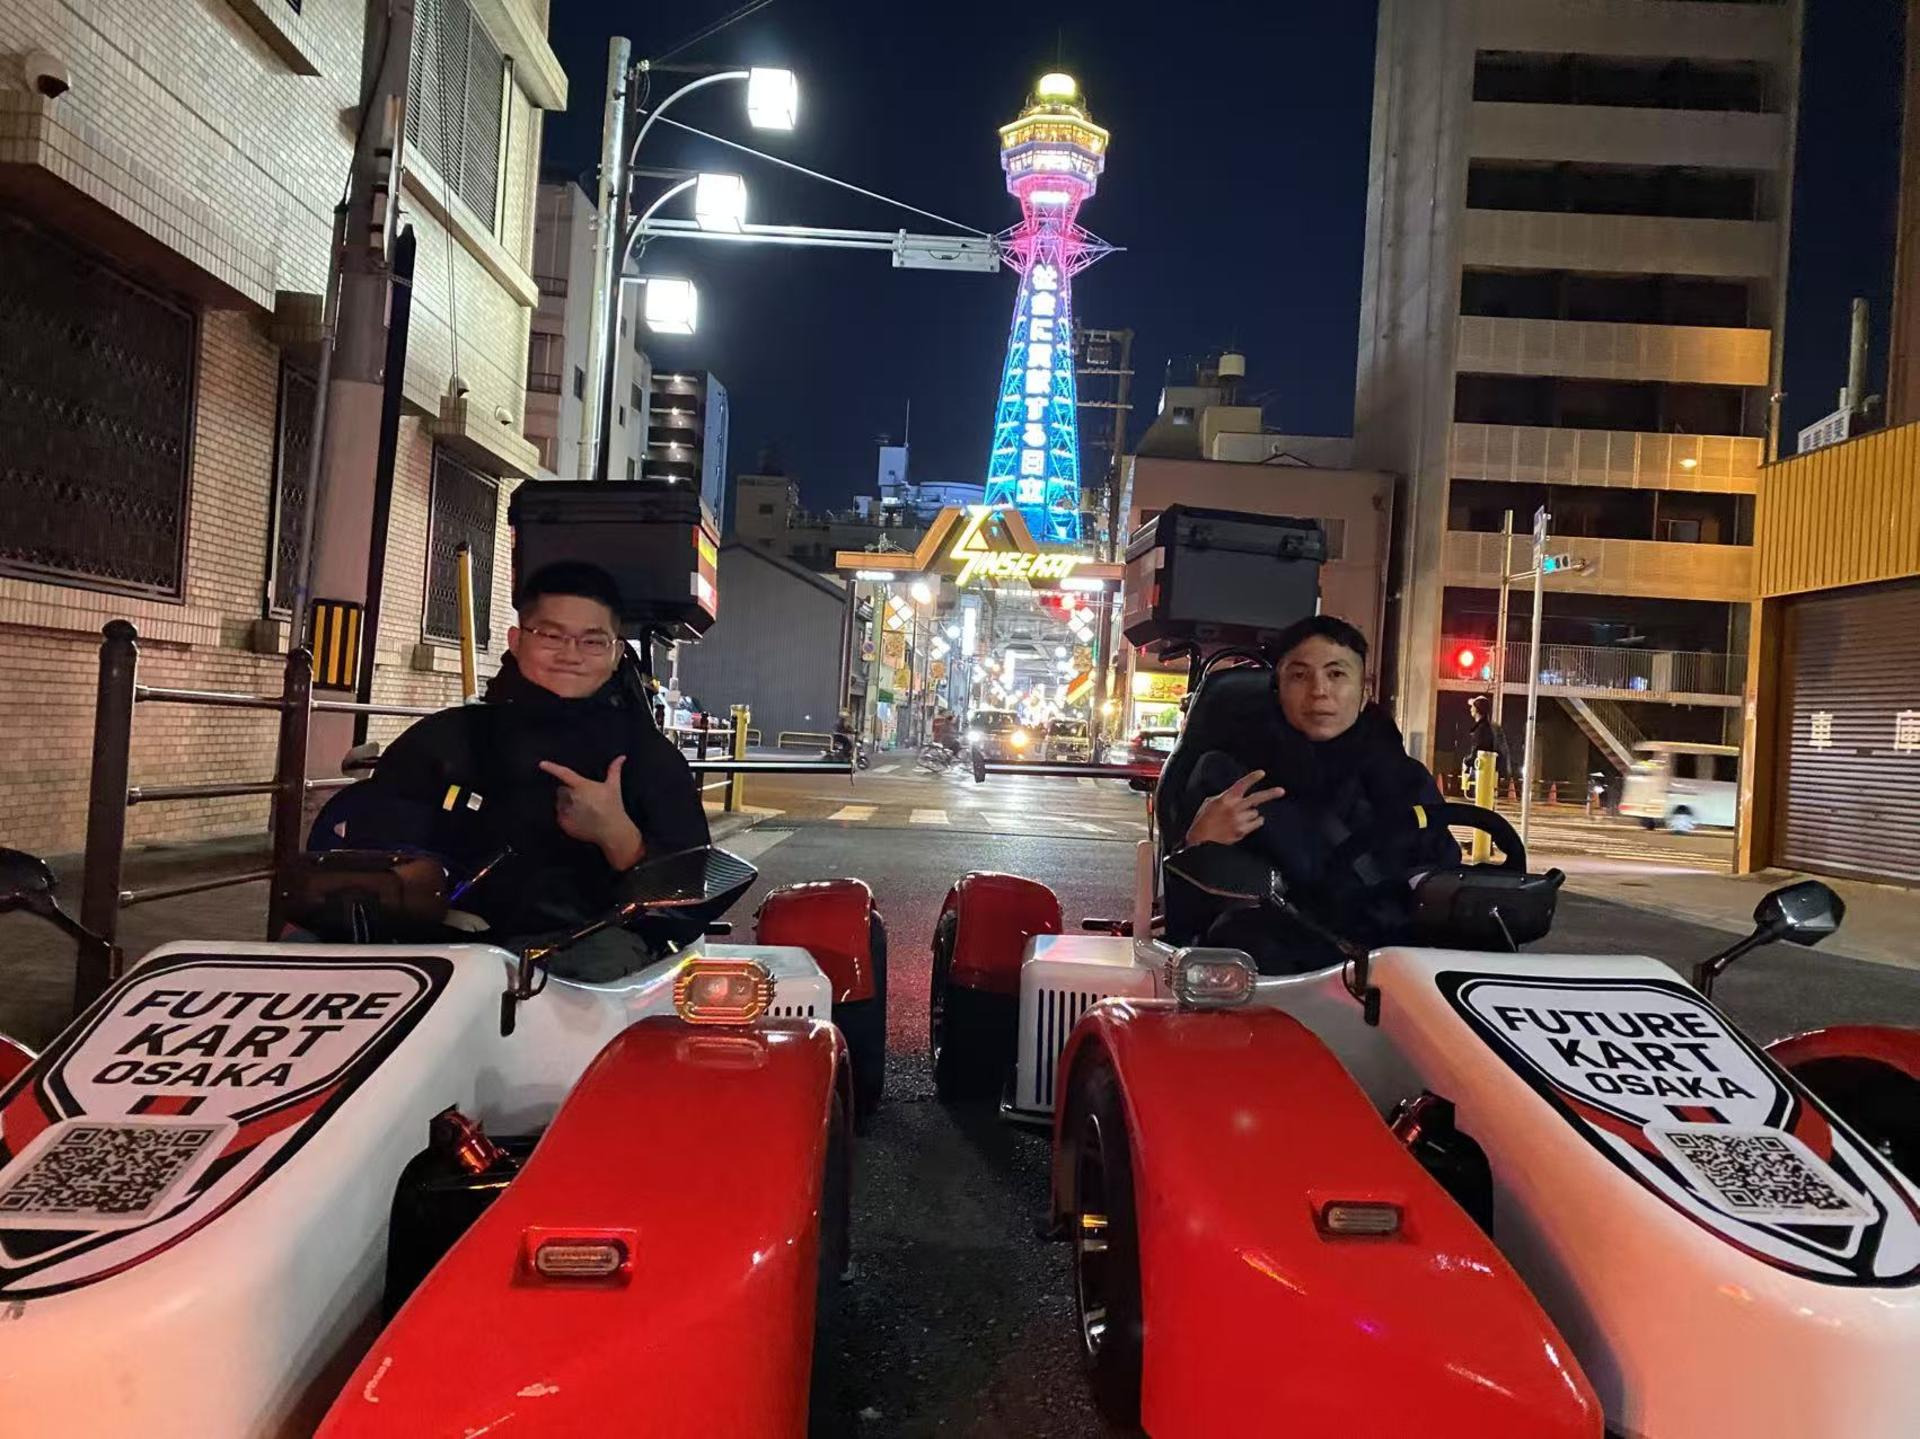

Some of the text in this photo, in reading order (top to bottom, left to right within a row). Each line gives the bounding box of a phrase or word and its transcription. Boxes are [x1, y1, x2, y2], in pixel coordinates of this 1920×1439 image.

[124, 990, 402, 1021] FUTURE
[1493, 1006, 1720, 1038] FUTURE
[117, 1024, 345, 1057] KART
[1549, 1039, 1721, 1072] KART
[92, 1061, 292, 1086] OSAKA
[1584, 1073, 1756, 1099] OSAKA
